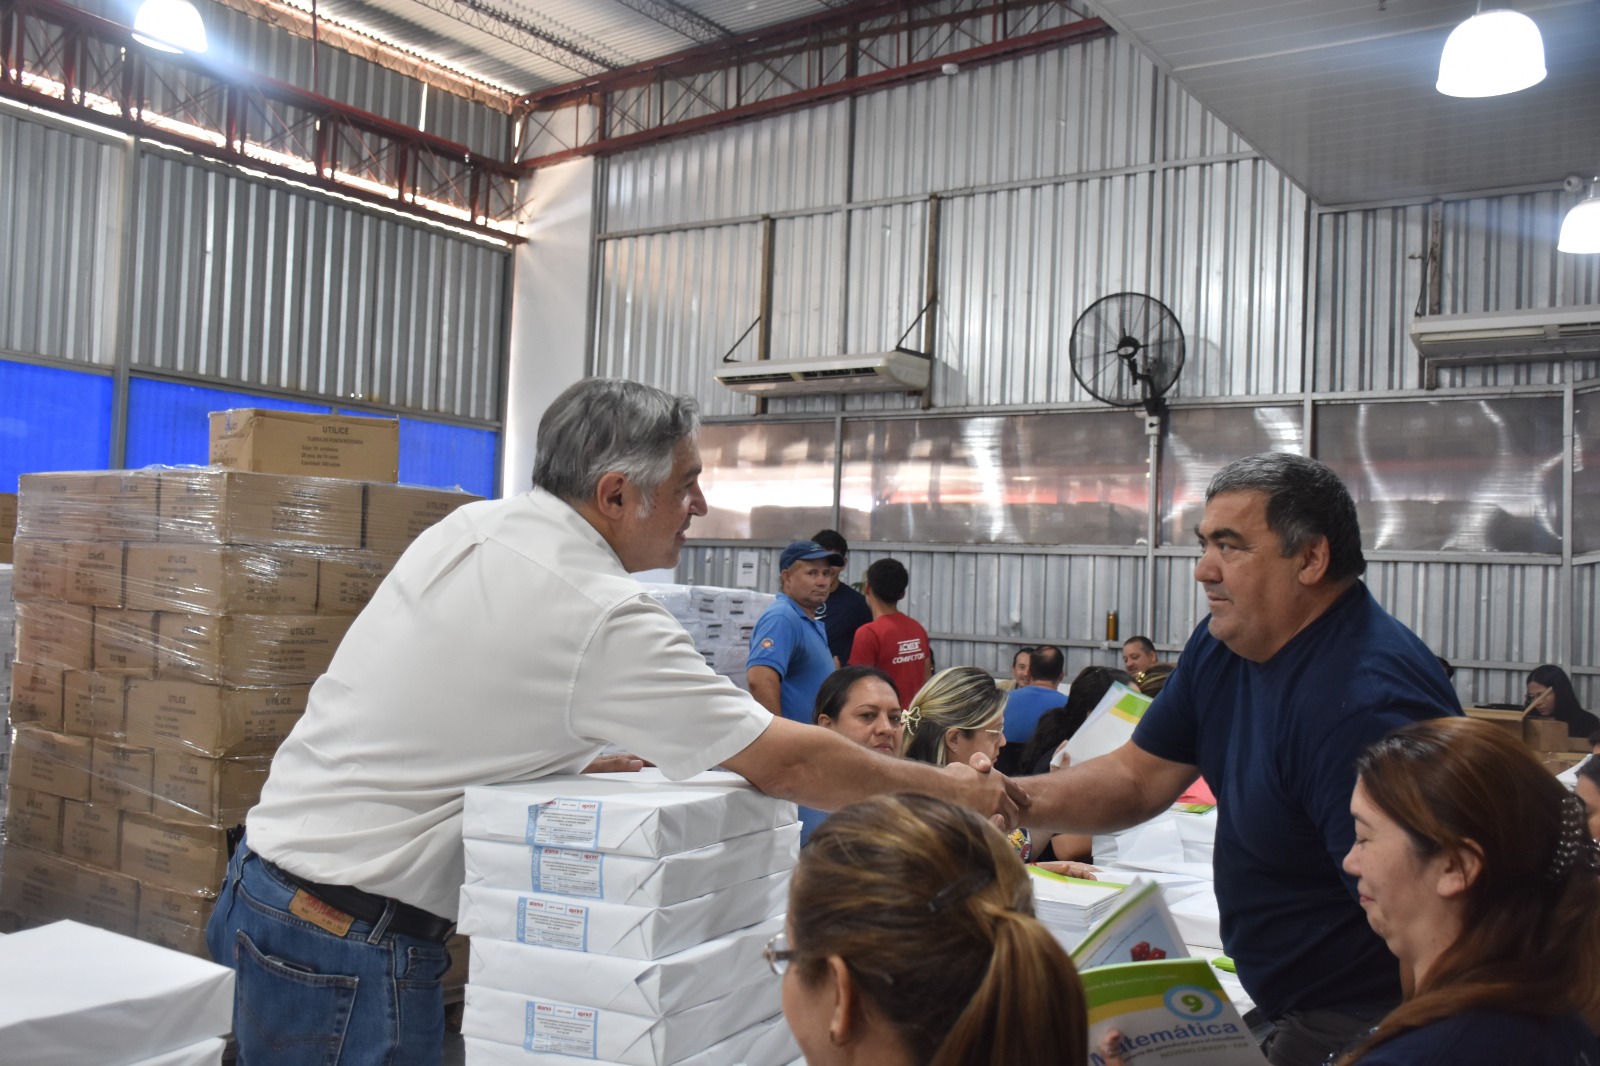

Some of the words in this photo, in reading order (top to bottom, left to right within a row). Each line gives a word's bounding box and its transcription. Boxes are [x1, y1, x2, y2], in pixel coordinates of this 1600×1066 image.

[322, 426, 350, 435] UTILICE
[265, 698, 292, 706] UTILICE
[1181, 994, 1204, 1013] 9
